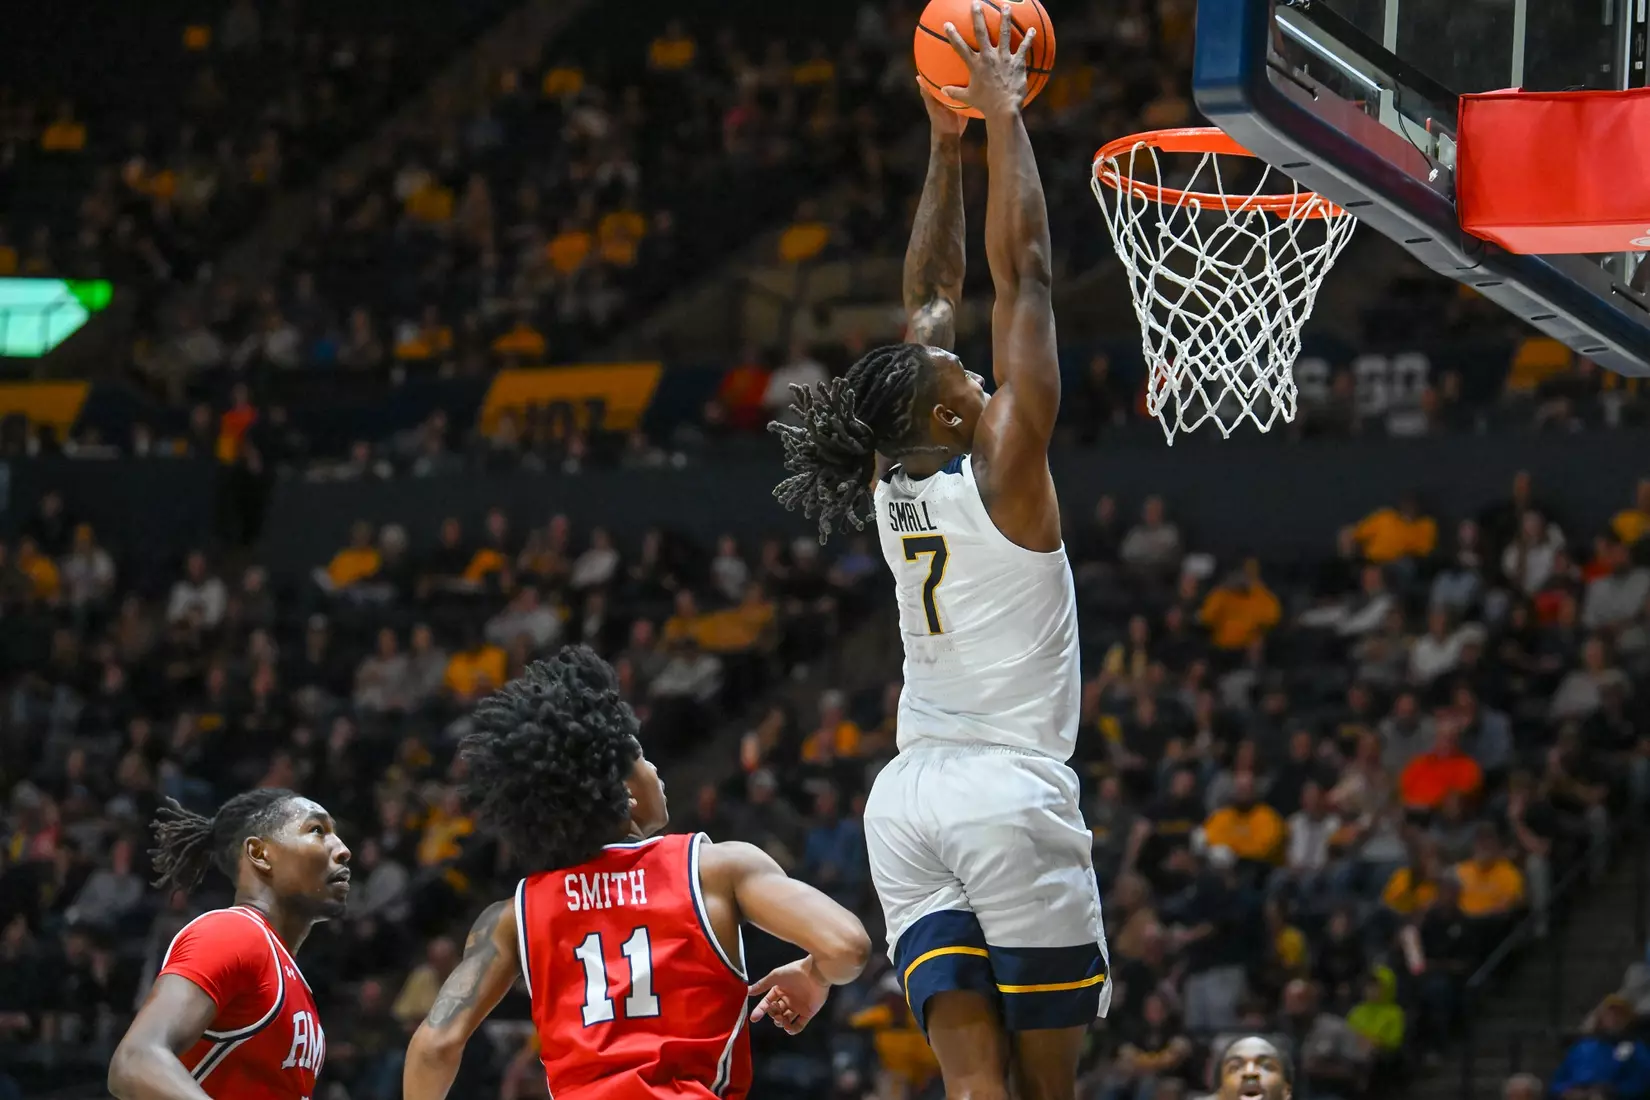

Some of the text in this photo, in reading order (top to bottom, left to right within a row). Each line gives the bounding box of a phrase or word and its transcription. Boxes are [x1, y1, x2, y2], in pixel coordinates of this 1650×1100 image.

[888, 500, 938, 532] SMALL
[900, 533, 950, 636] 7
[564, 868, 648, 912] SMITH
[573, 925, 661, 1028] 11
[281, 1010, 327, 1080] RM
